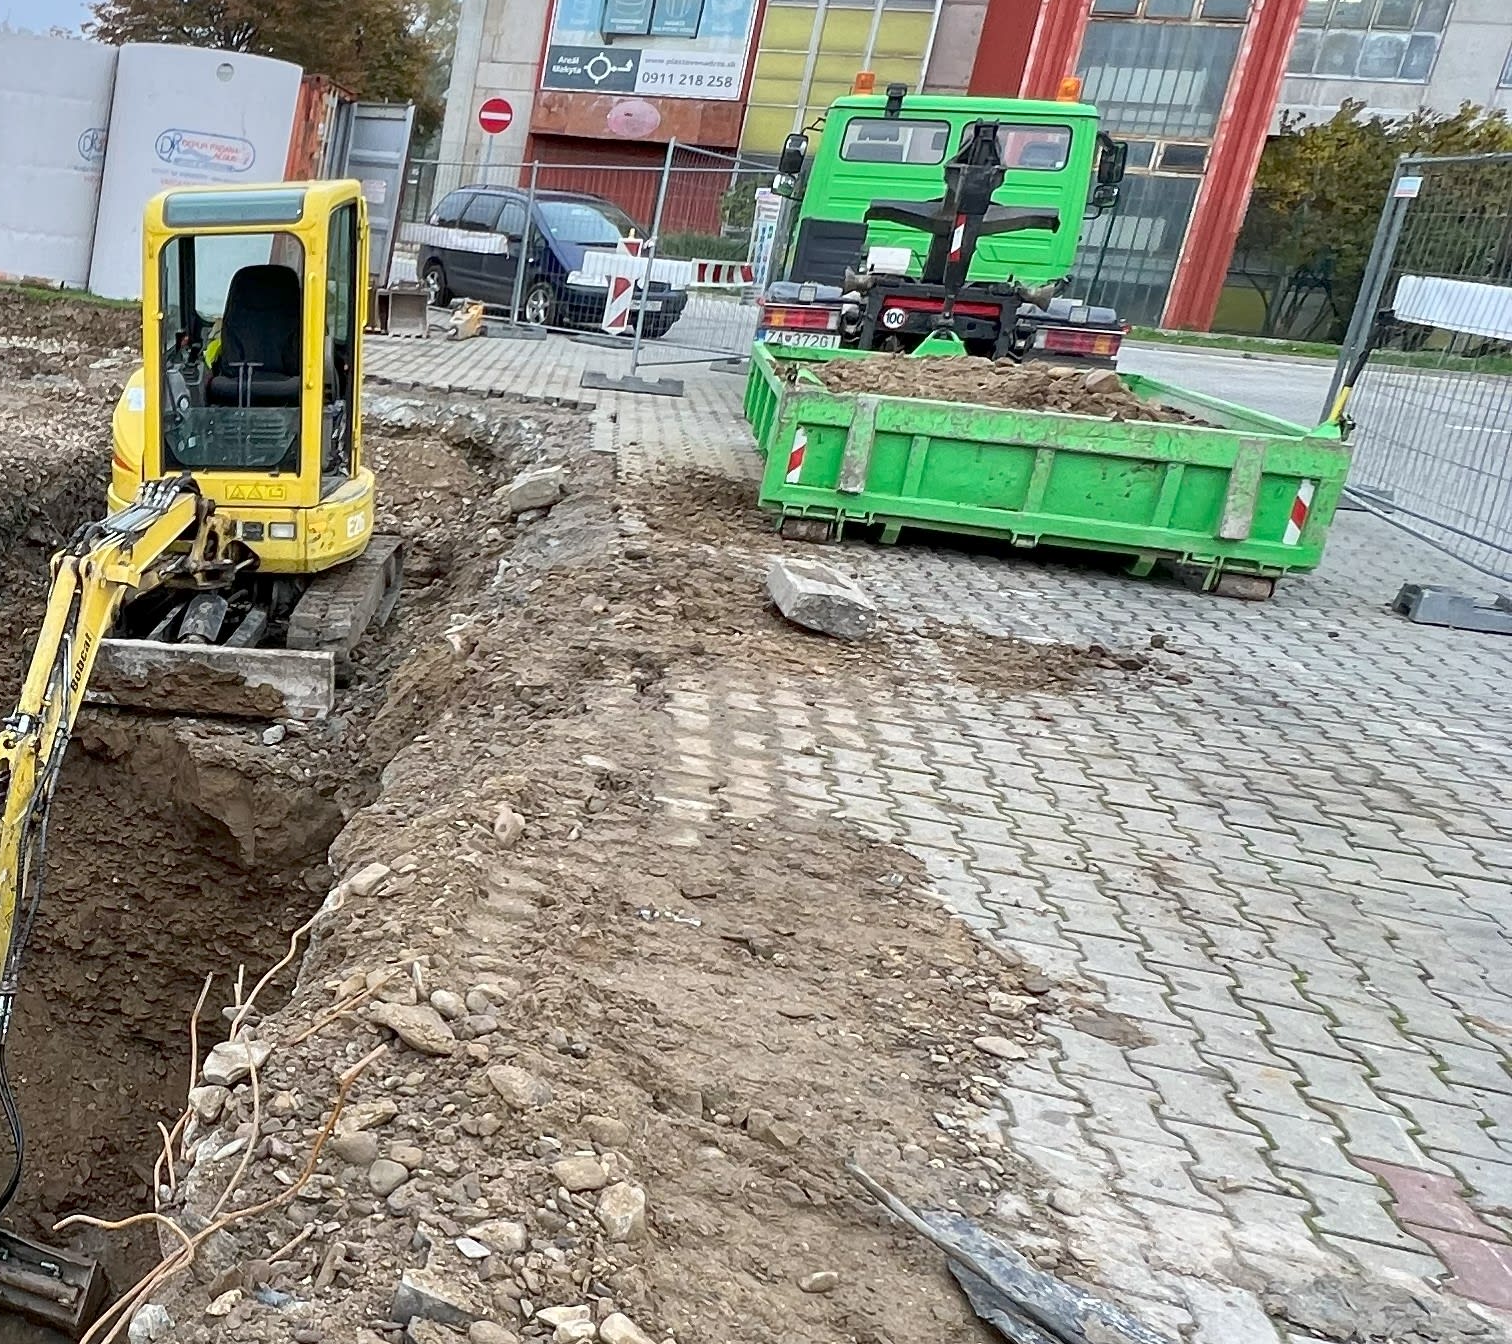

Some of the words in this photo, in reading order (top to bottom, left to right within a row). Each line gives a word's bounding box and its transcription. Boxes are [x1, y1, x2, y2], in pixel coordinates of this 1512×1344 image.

[642, 71, 674, 85] 0911
[679, 74, 703, 86] 218
[707, 75, 733, 88] 258
[886, 312, 904, 325] 100
[70, 632, 92, 694] Bobcat
